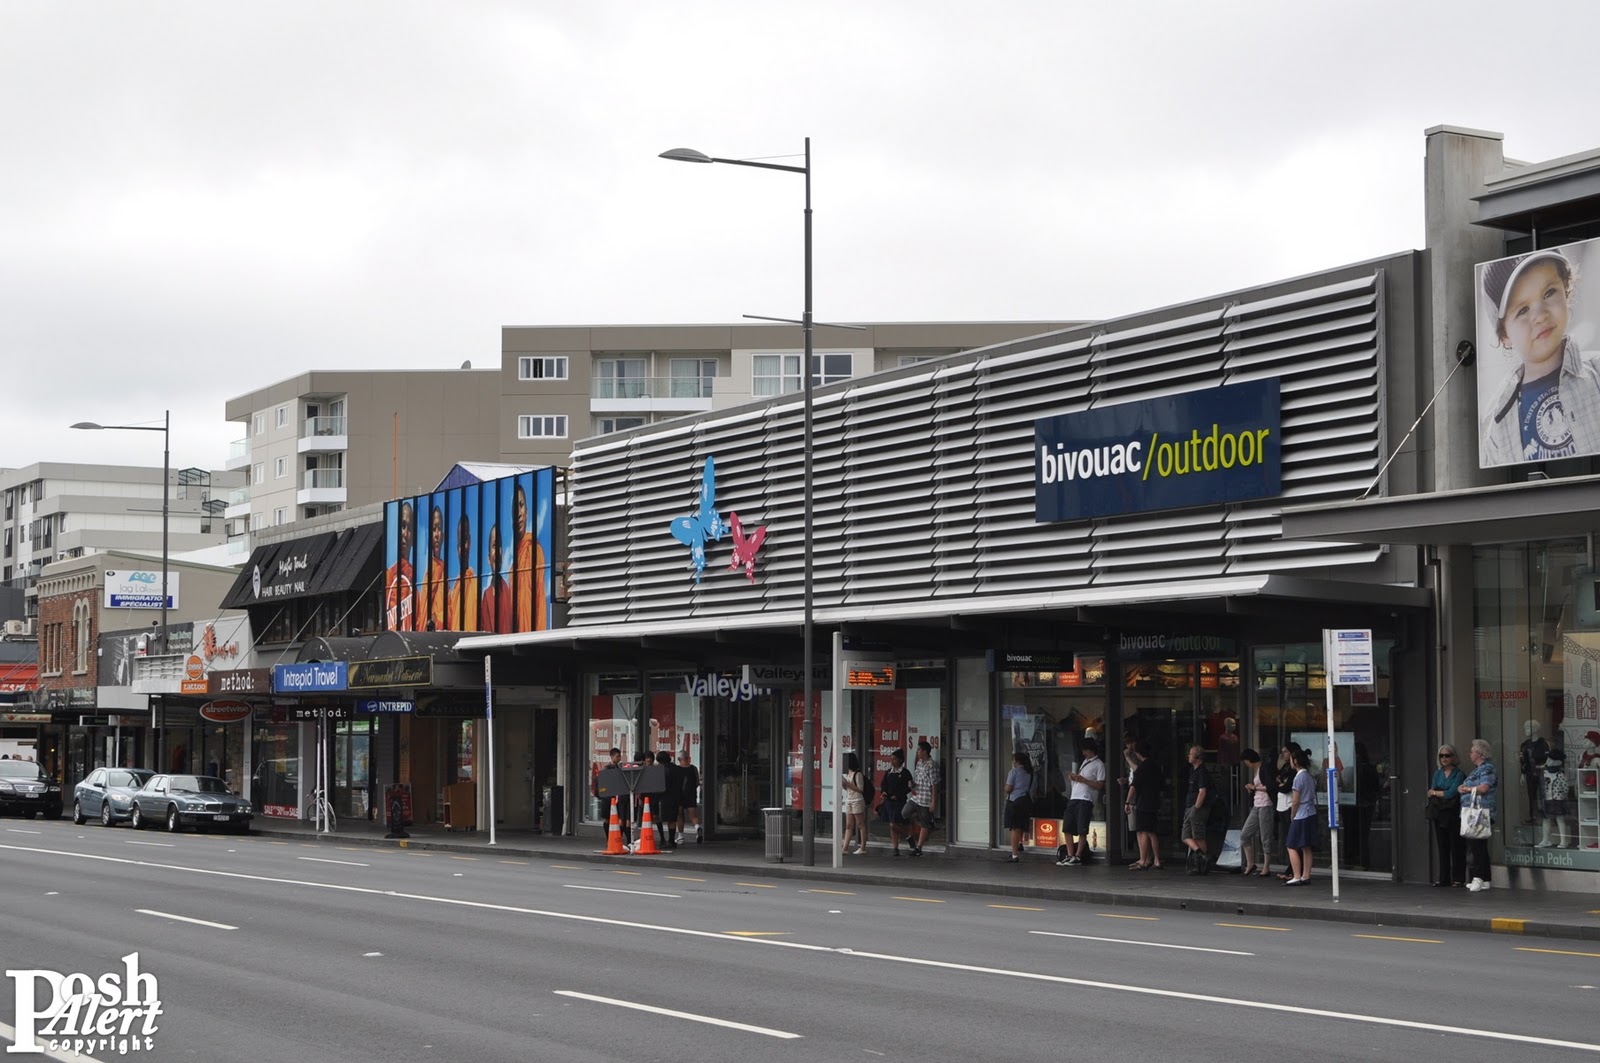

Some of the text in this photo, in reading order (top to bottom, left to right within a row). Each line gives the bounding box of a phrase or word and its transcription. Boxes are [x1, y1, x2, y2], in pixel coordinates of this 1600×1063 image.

[1041, 441, 1142, 485] bivouac
[261, 581, 305, 597] HAIR BEAUTY NAIL
[1120, 632, 1165, 650] bivouac
[1006, 653, 1032, 662] bivouac
[283, 666, 338, 687] Intrepid Travel
[184, 683, 206, 691] tattoo
[1477, 691, 1528, 699] NEW FASHION
[205, 702, 249, 713] streetwise
[379, 702, 412, 712] INTREPID
[882, 729, 899, 741] End of
[1504, 850, 1573, 866] Pumpkin Patch
